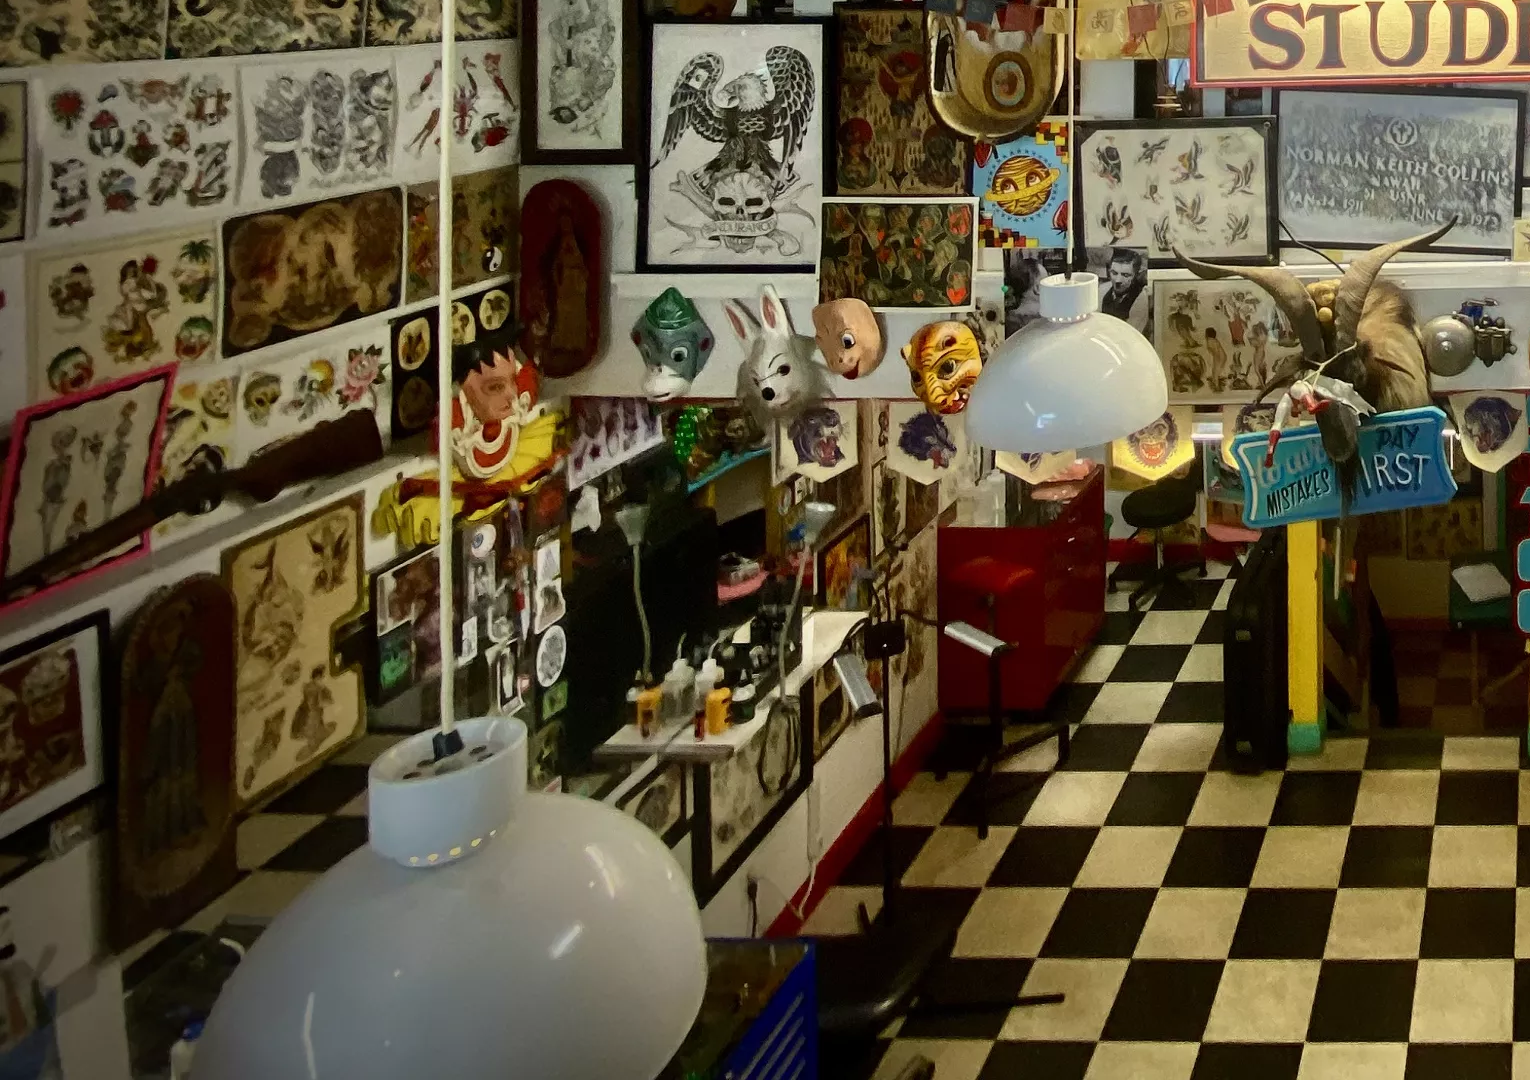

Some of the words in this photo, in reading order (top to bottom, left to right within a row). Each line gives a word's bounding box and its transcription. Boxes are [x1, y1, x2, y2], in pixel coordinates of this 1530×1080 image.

[1286, 145, 1369, 170] NORMAN
[1375, 155, 1428, 176] KEITH
[1432, 163, 1510, 186] COLLINS
[1376, 425, 1420, 450] PAY
[1356, 452, 1432, 493] IRST
[1266, 468, 1331, 519] MISTAKES
